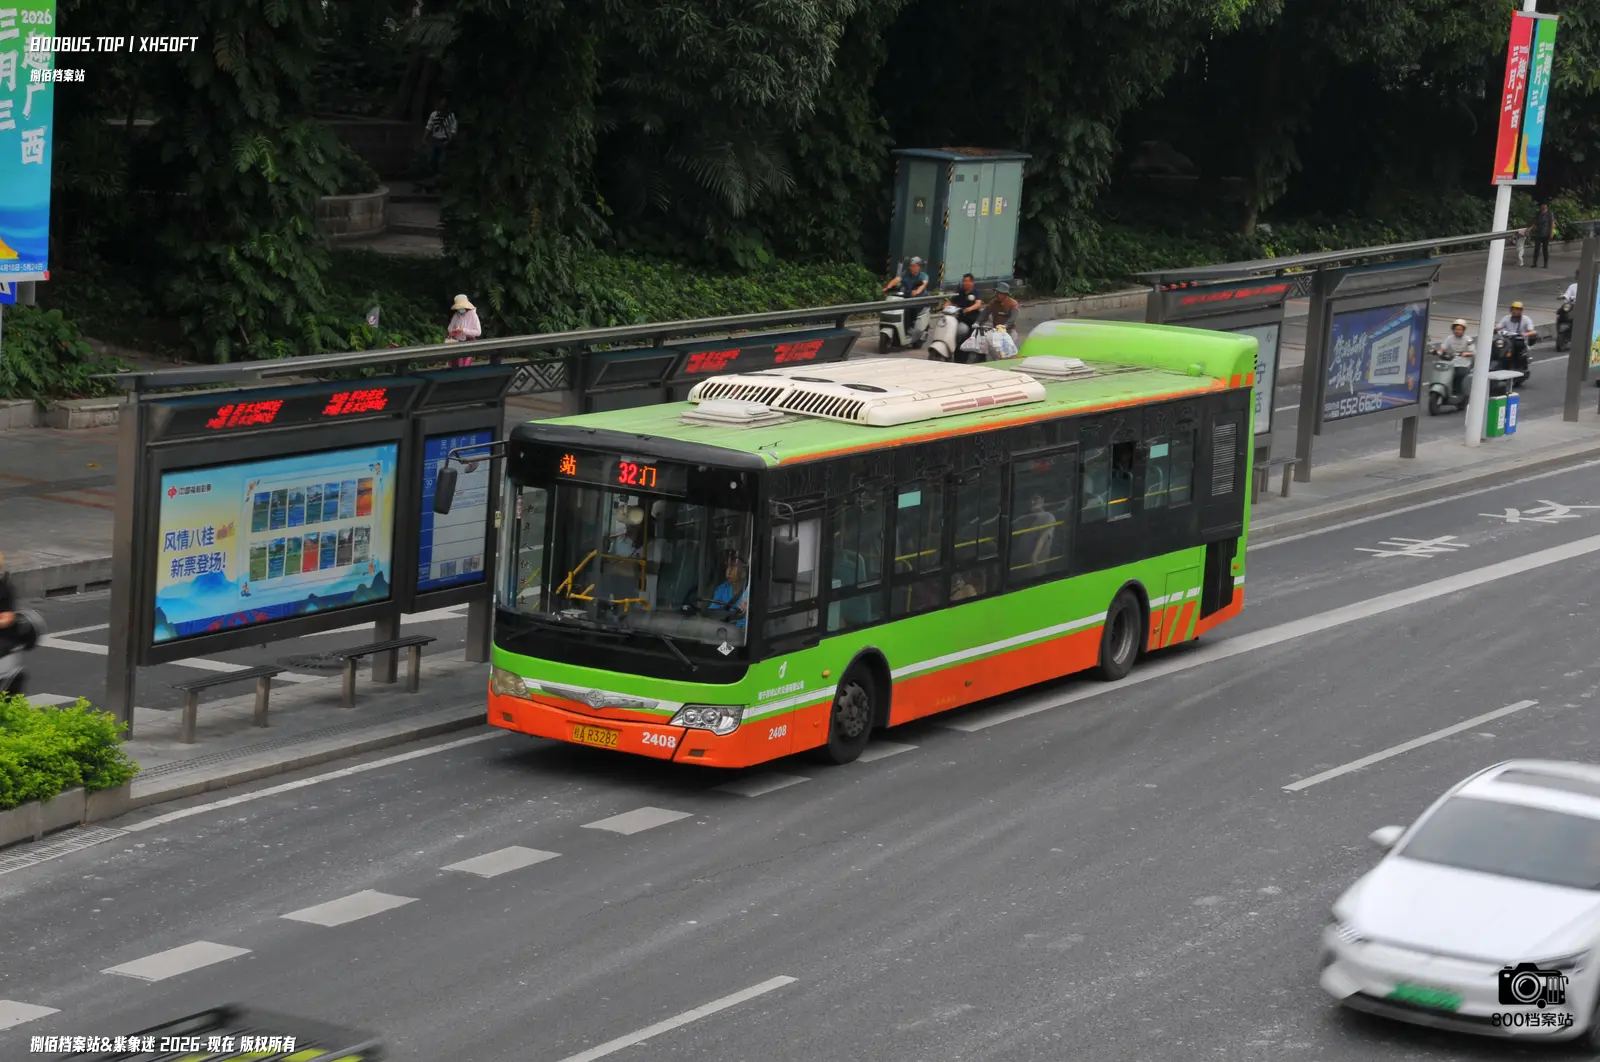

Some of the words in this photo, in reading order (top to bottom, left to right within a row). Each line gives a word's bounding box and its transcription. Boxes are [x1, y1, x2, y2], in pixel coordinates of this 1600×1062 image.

[21, 10, 52, 24] 2026
[618, 461, 639, 485] 32
[163, 525, 215, 552] 风情八桂
[642, 732, 676, 748] 2408
[768, 724, 787, 741] 2408
